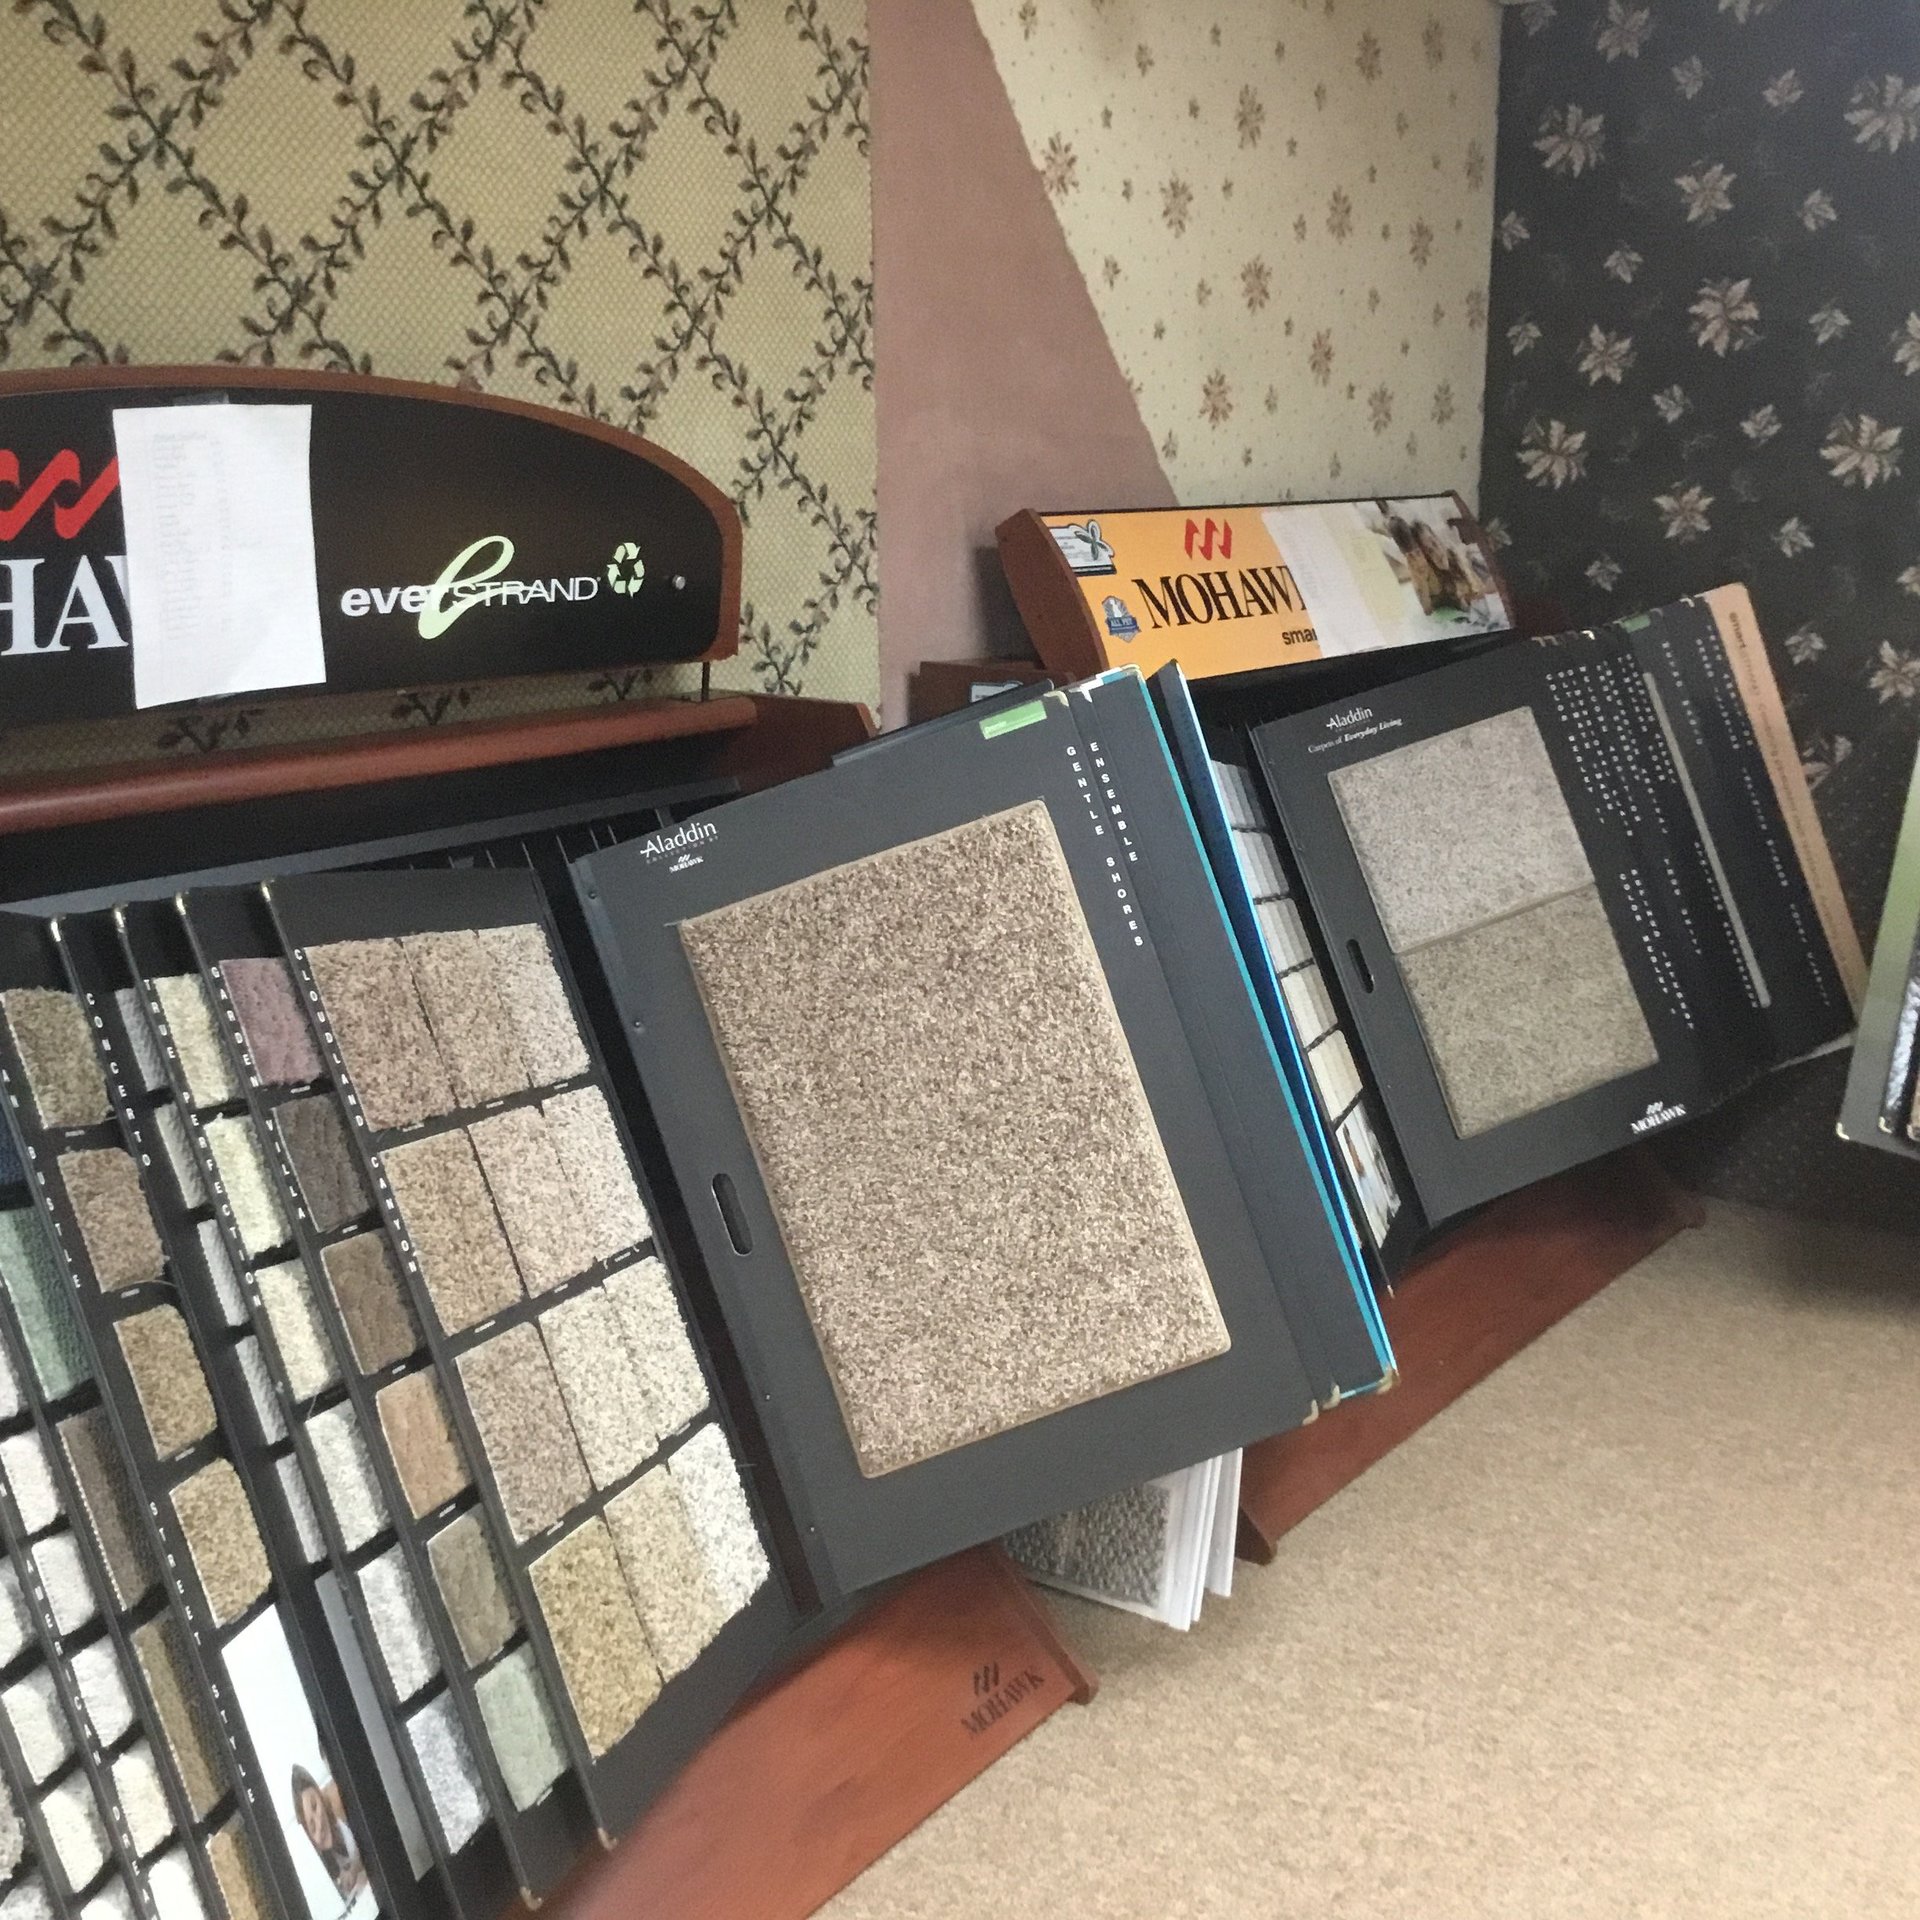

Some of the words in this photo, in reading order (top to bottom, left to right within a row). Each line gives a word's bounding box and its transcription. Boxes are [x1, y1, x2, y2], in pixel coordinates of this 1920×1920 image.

[1131, 565, 1307, 629] MOHAW
[1326, 706, 1373, 730] Aladdin
[1344, 726, 1379, 742] Everyday
[1546, 674, 1567, 721] COLOR
[1569, 736, 1592, 792] MEDLEY
[639, 822, 717, 858] Aladdin
[1066, 746, 1104, 836] GENTLE
[1106, 856, 1143, 947] SHORES
[1090, 741, 1138, 862] ENSEMBLE
[1620, 874, 1641, 921] COLOR
[1643, 936, 1667, 993] MEDLEY
[86, 992, 151, 1167] CONCERTO
[211, 966, 260, 1087] GARDEN
[265, 1118, 306, 1219] VILLA
[294, 949, 364, 1127] CLOUDLAND
[371, 1156, 417, 1273] CANYON
[142, 978, 176, 1059] TRUE
[182, 1091, 262, 1308] PERFECTION
[27, 1145, 82, 1288] BUSTLE
[149, 1501, 202, 1646] STREET
[211, 1683, 256, 1804] STYLE
[961, 1669, 1046, 1739] MOHAWK
